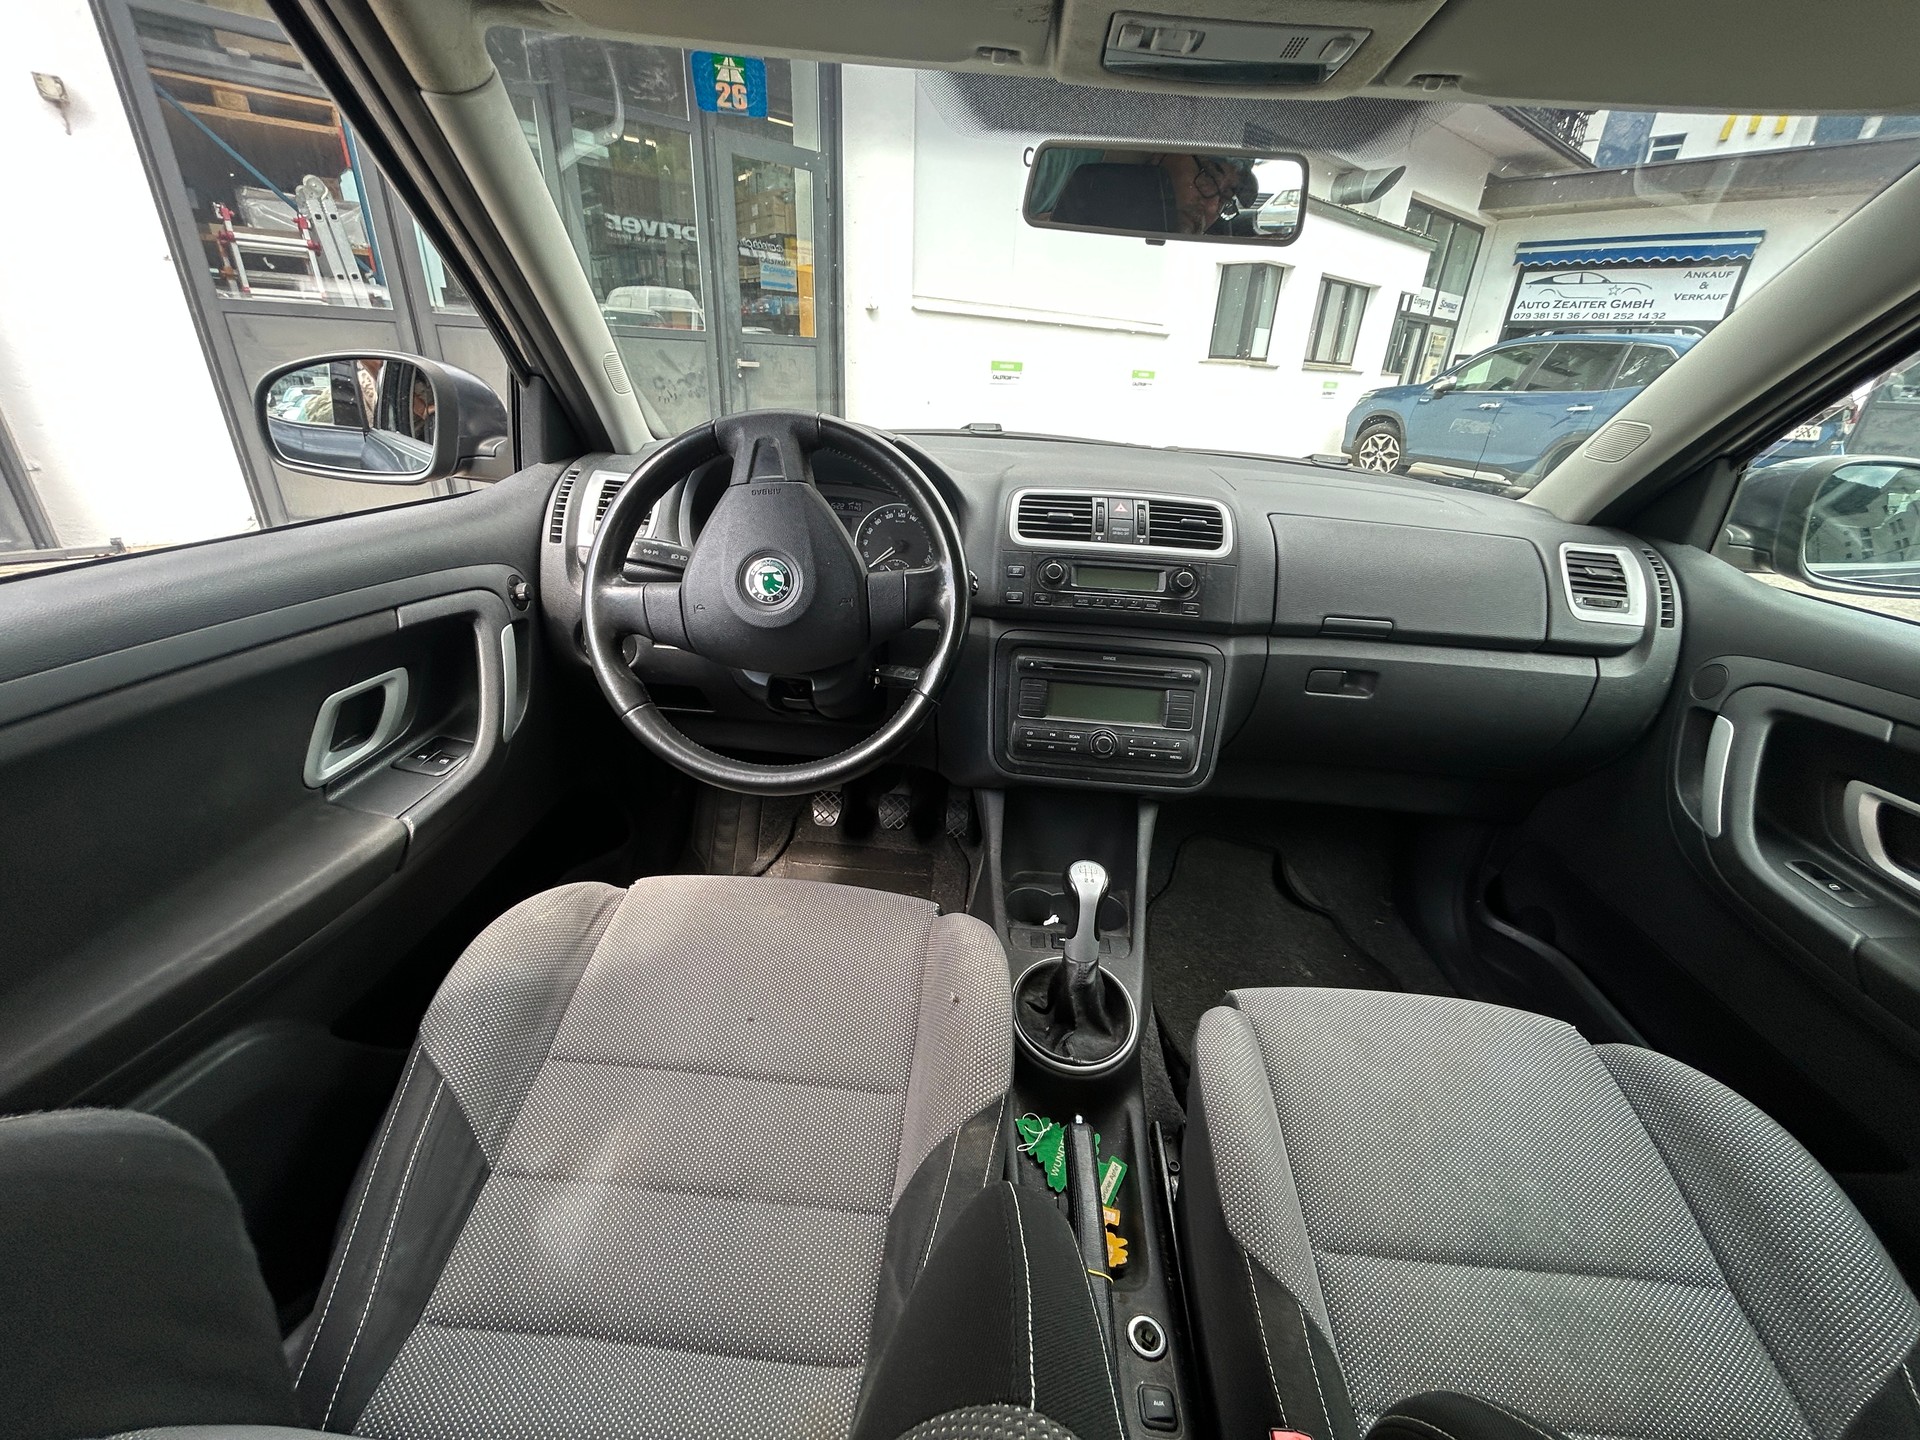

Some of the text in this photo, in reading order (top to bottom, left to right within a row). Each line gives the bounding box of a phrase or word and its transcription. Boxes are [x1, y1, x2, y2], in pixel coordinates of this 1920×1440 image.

[715, 82, 748, 110] 26
[1683, 270, 1736, 279] ANKAUF
[1698, 281, 1710, 290] &
[1673, 292, 1729, 301] VERKAUF
[1516, 300, 1550, 310] AUTO
[1552, 299, 1608, 310] ZEAITER
[1513, 312, 1532, 320] 079
[1533, 312, 1550, 320] 381
[1555, 312, 1564, 320] 51
[1566, 312, 1580, 320] 36
[1591, 312, 1611, 320] 081
[1613, 312, 1634, 320] 252
[1638, 312, 1649, 320] 14
[1651, 312, 1666, 320] 32
[751, 488, 782, 496] AIRBAG
